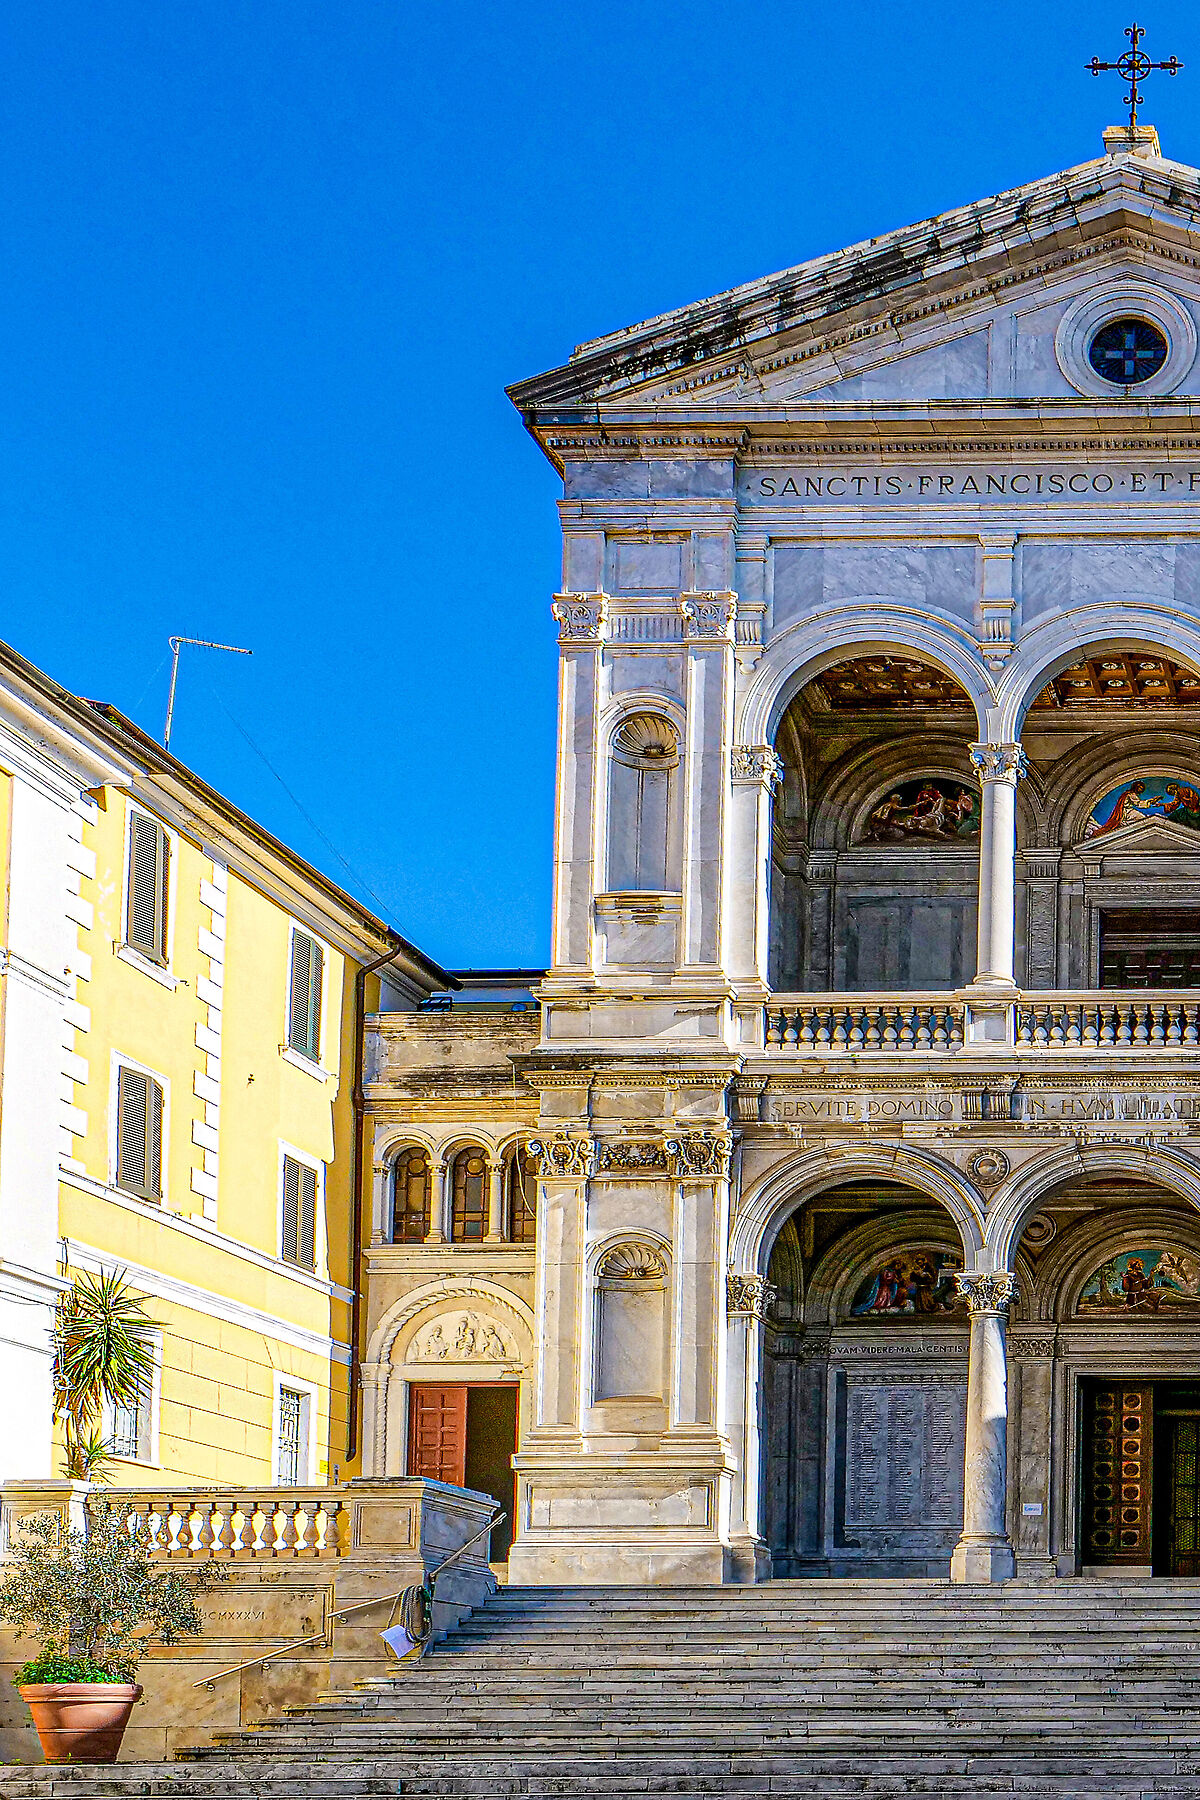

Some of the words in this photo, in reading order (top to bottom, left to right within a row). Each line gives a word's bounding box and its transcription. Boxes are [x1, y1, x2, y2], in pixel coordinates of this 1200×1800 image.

[758, 475, 903, 497] SANCTIS
[917, 473, 1114, 495] FRANCISCO
[1130, 472, 1175, 492] ET
[772, 1100, 856, 1117] SERVITE
[868, 1100, 954, 1116] DOMINO
